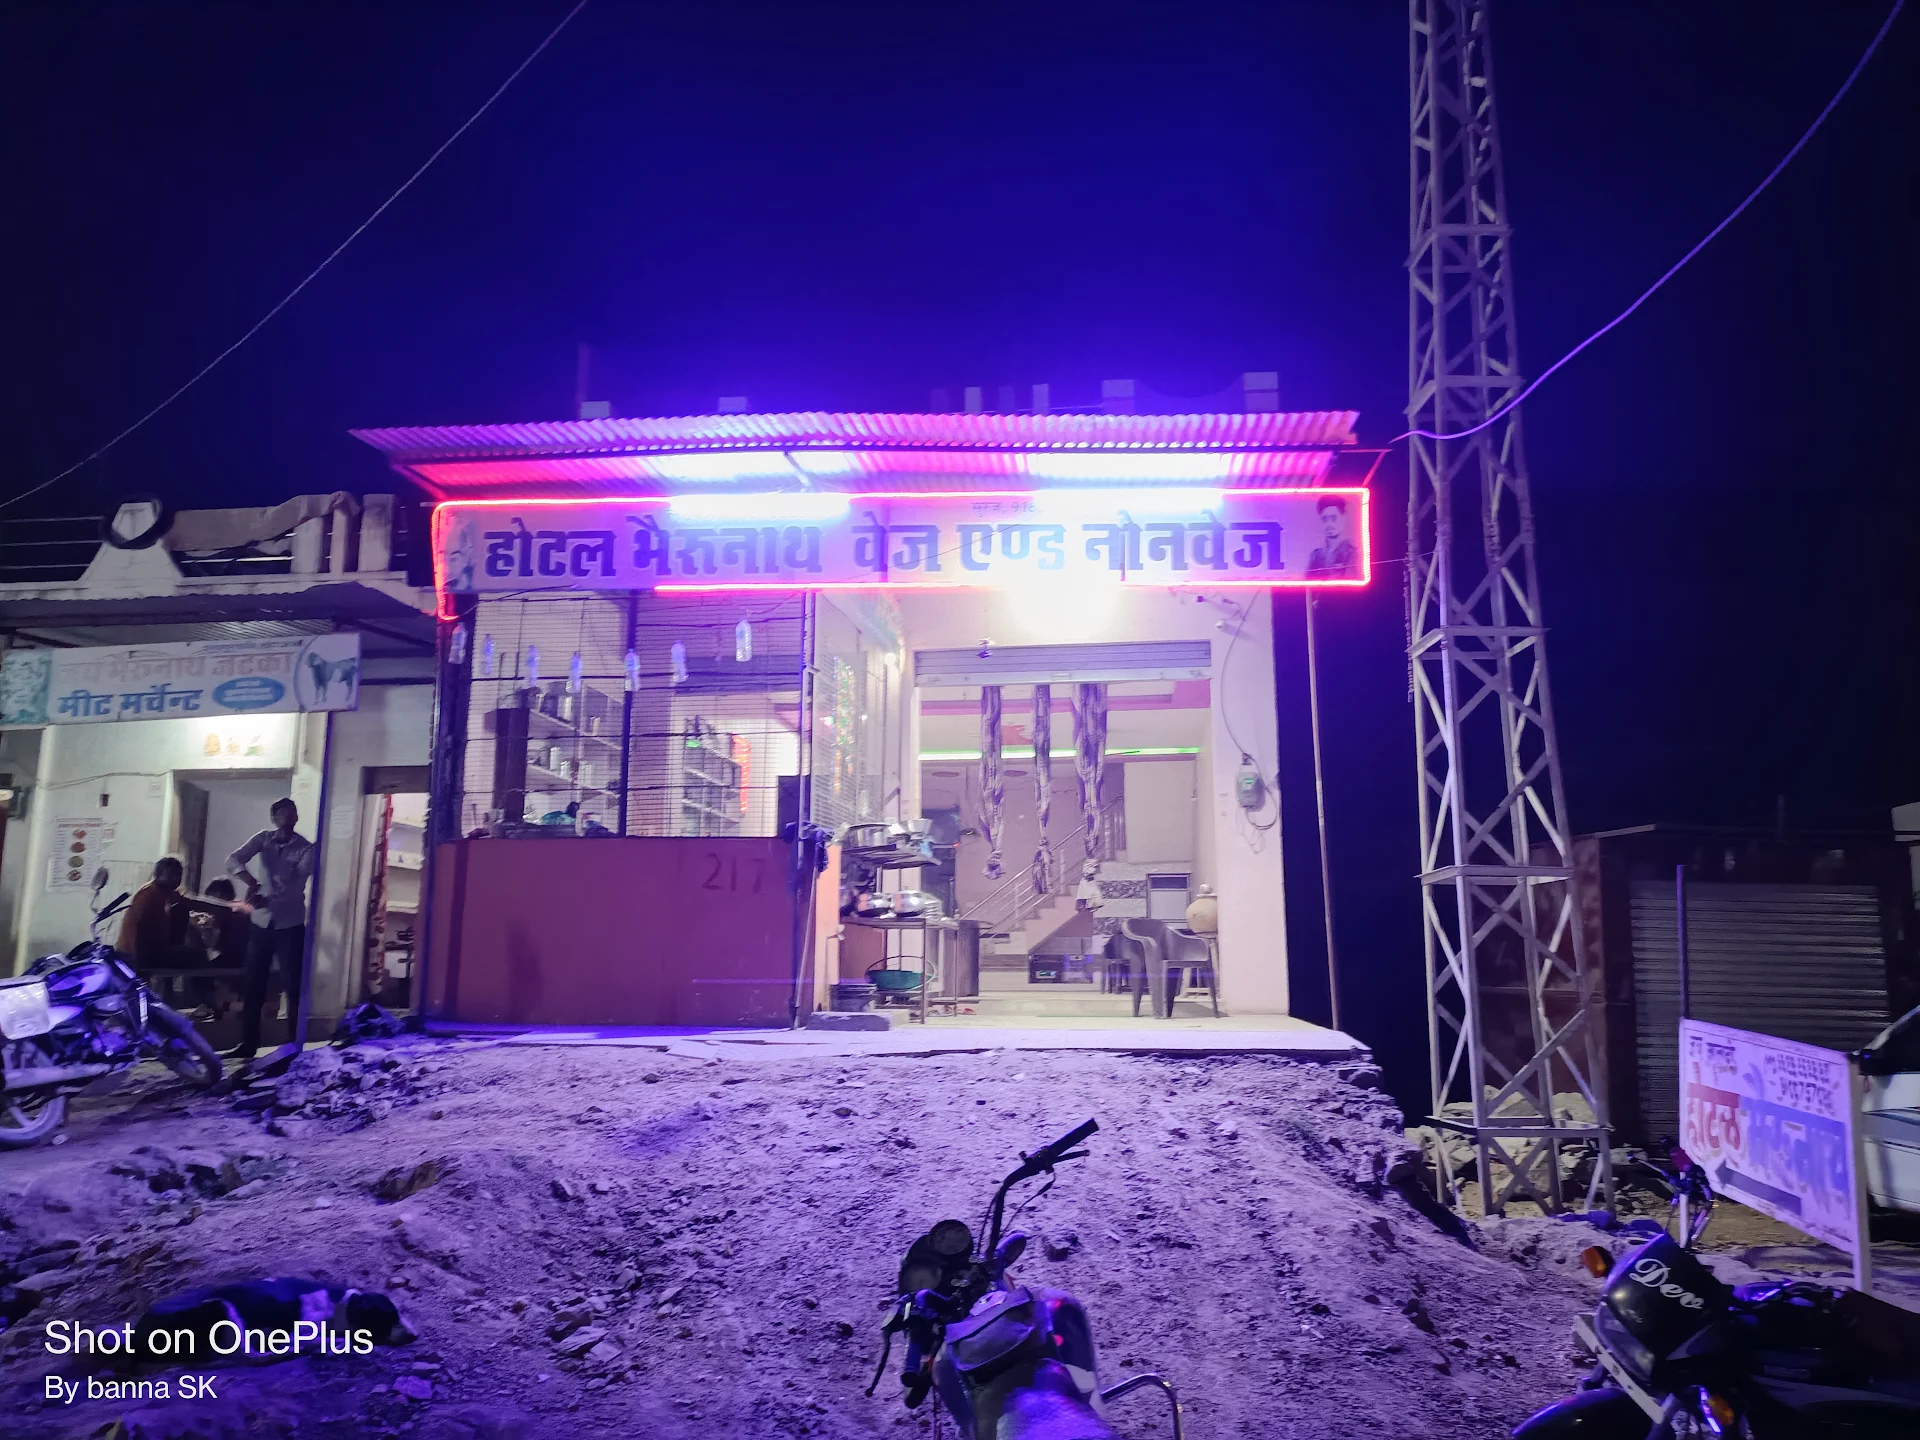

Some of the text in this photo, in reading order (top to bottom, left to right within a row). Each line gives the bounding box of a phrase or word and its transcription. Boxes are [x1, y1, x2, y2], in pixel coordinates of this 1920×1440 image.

[484, 517, 616, 577] होटल
[851, 511, 941, 573] वेज
[955, 524, 1067, 572] एण्ड
[1082, 508, 1285, 571] नोनवेज
[57, 689, 113, 717] मीट
[702, 852, 765, 894] 217
